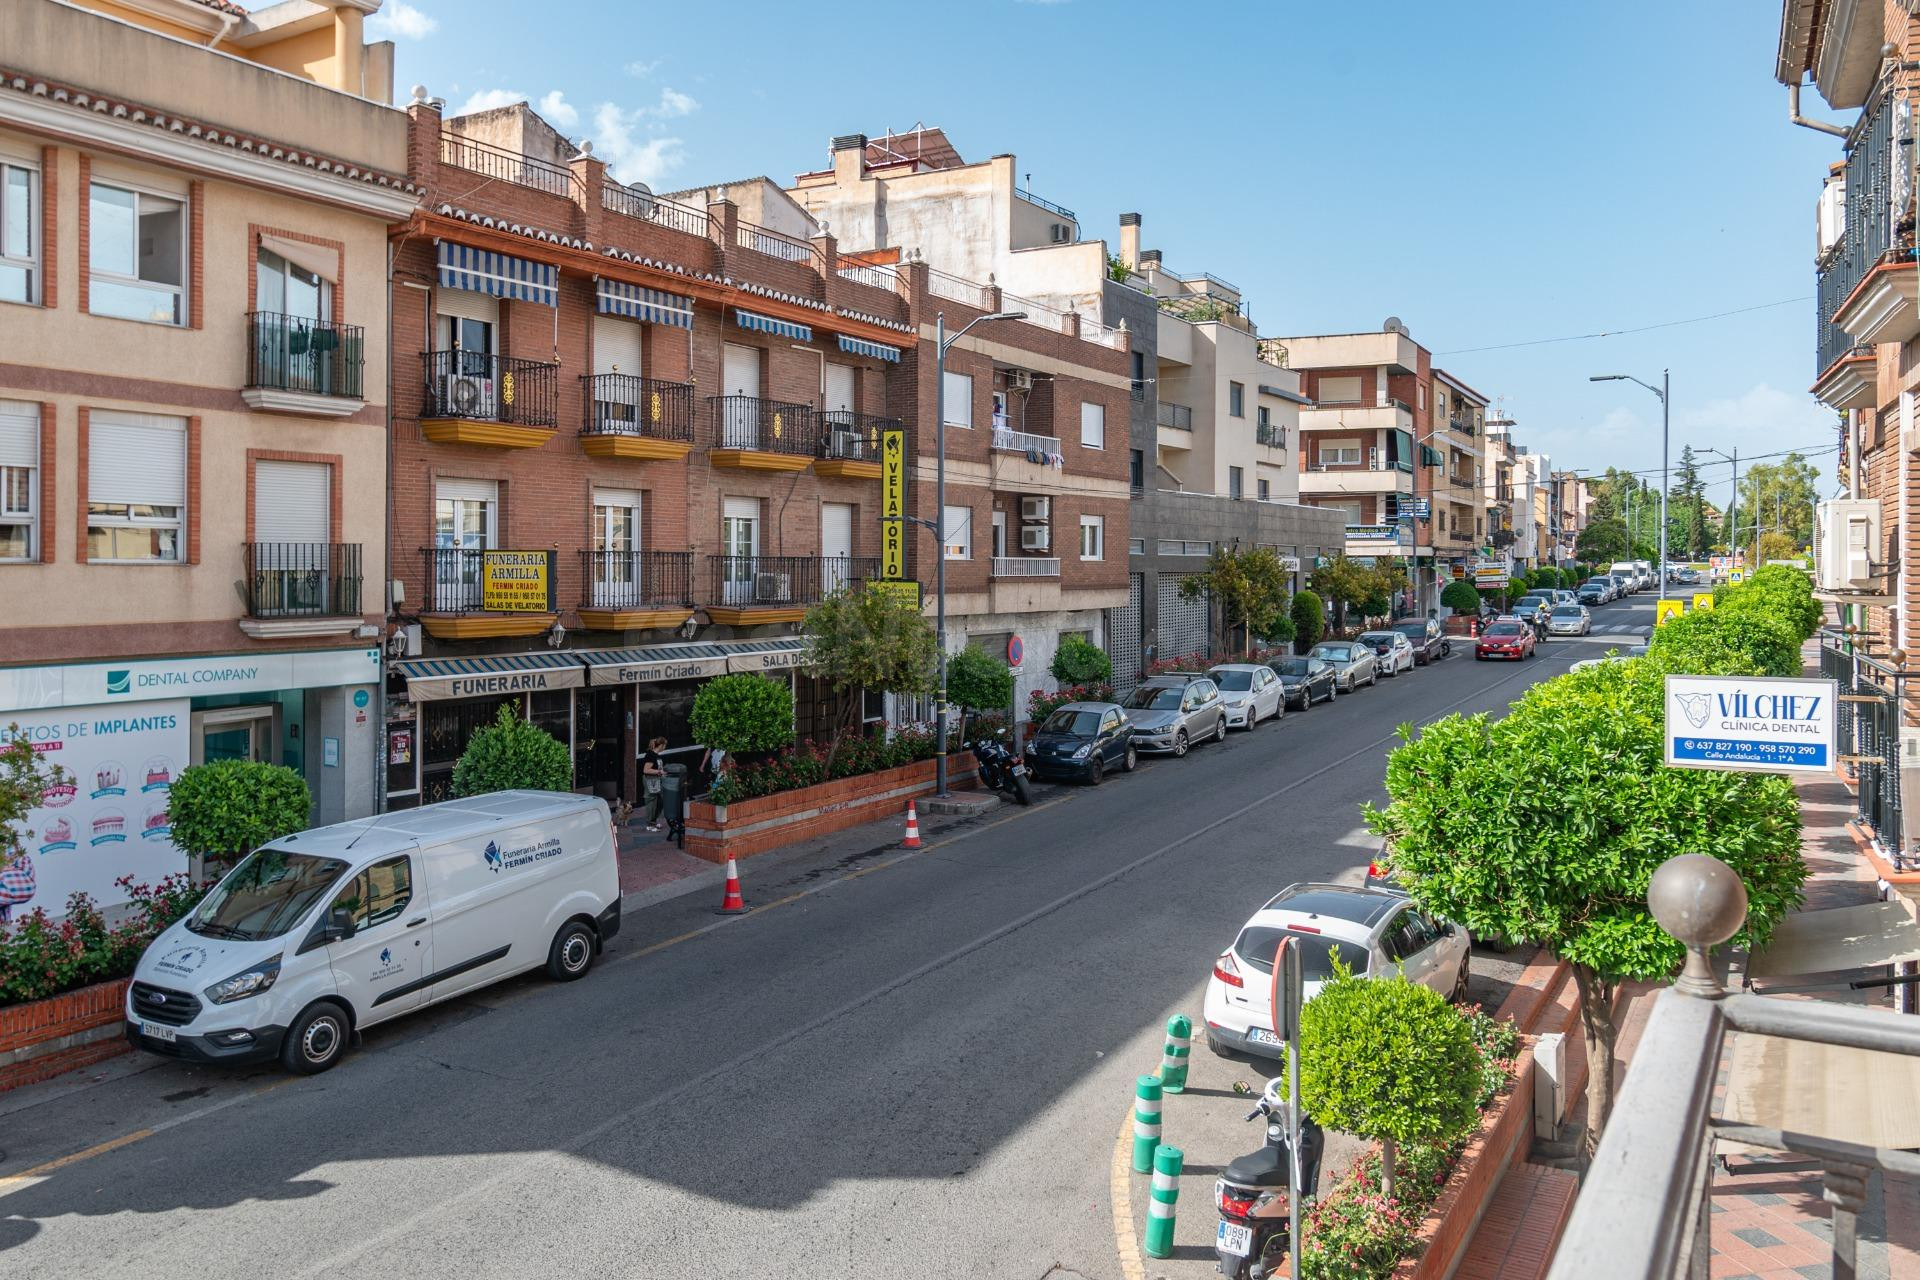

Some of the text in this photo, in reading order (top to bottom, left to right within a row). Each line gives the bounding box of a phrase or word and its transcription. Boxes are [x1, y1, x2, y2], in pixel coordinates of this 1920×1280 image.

[887, 462, 898, 576] VELATORIO
[486, 554, 546, 566] FUNERARIA
[491, 568, 540, 579] ARMILLA
[514, 602, 546, 610] VELATORIO
[763, 654, 789, 667] SALA
[138, 667, 258, 687] DENTAL COMPANY
[618, 663, 702, 681] Fermín Criado
[452, 674, 548, 696] FUNERARIA
[1718, 689, 1821, 721] VÍLCHEZ
[67, 722, 88, 738] DE
[94, 714, 177, 735] IMPLANTES
[1721, 719, 1821, 734] CLÍNICA DENTAL
[1696, 742, 1713, 750] 637
[1716, 743, 1731, 751] 827
[1736, 743, 1752, 752] 190
[1759, 744, 1776, 753] 958
[1778, 745, 1796, 753] 570
[1798, 746, 1816, 755] 290
[1705, 751, 1723, 760] Calle
[503, 838, 560, 860] Funeraria Armilla
[505, 847, 562, 869] FERMÍN CRIADO
[145, 1025, 174, 1039] 5717 LVP
[1226, 1225, 1247, 1240] 0891
[1224, 1236, 1242, 1250] LPN
